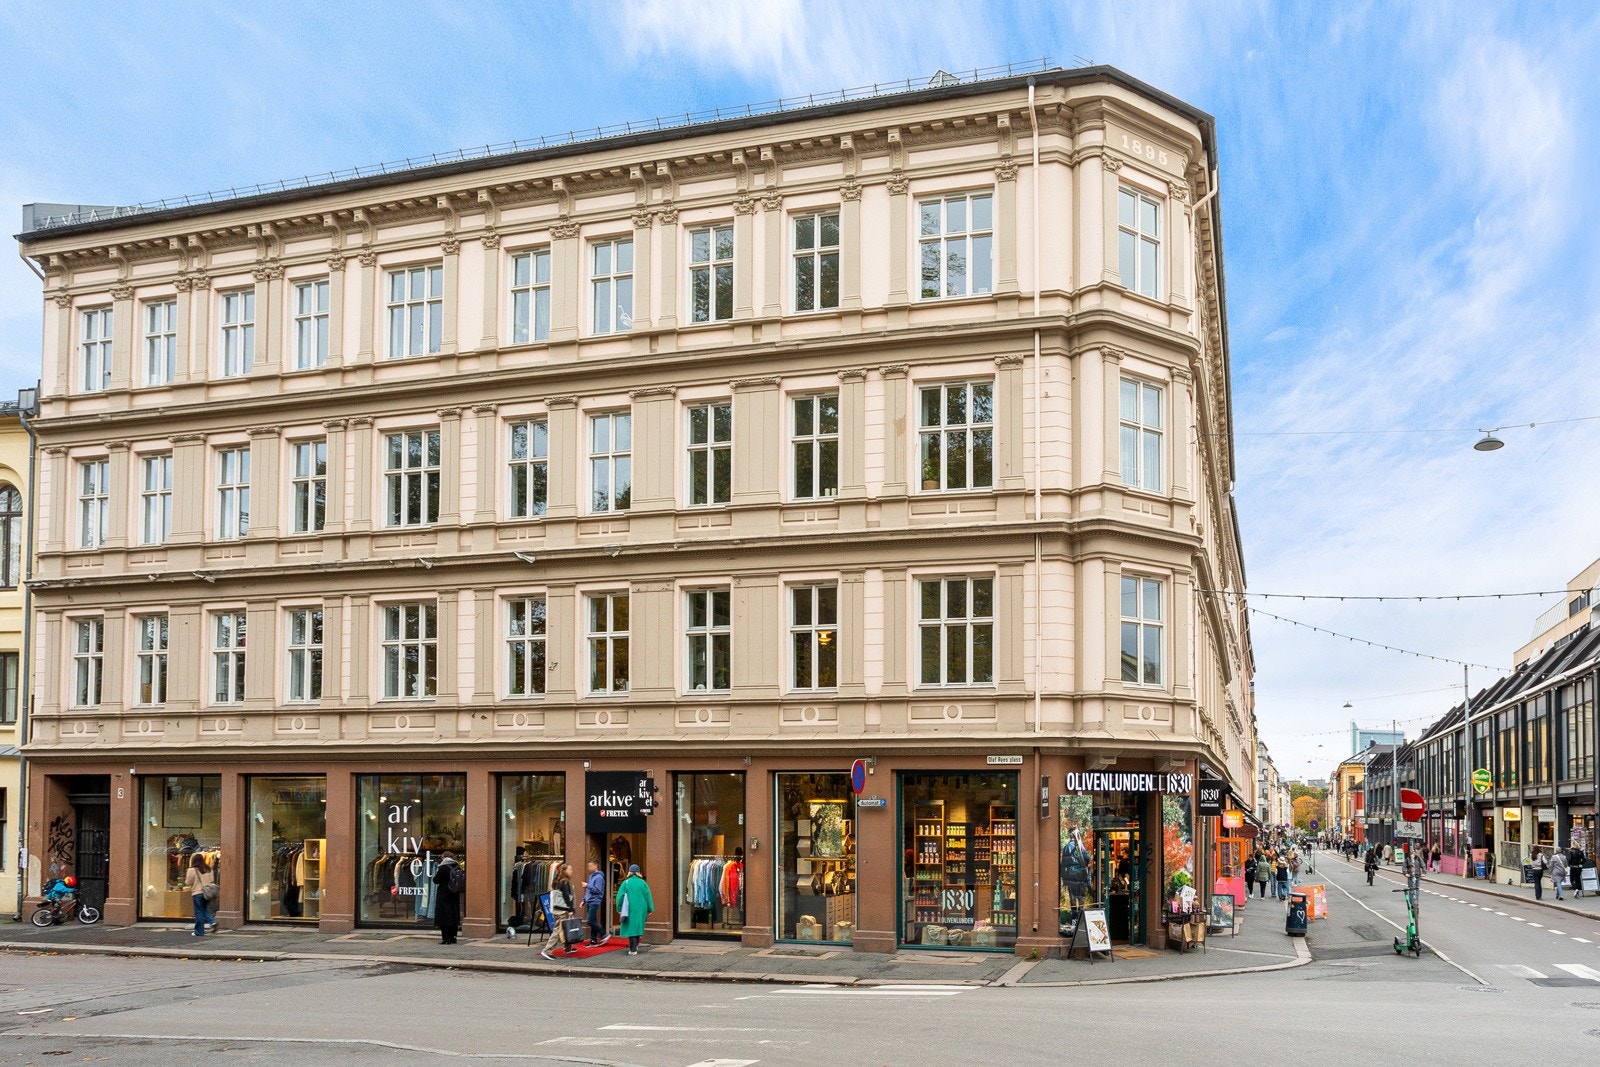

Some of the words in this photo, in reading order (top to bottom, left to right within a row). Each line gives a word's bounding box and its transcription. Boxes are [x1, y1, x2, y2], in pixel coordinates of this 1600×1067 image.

[1122, 135, 1168, 166] 1895
[639, 788, 650, 798] kiv
[1066, 772, 1153, 791] OLIVENLUNDEN
[1166, 773, 1193, 794] 1830
[590, 790, 636, 807] arkive
[1200, 789, 1220, 800] 1830
[388, 804, 412, 824] ar
[387, 827, 424, 855] kiv
[410, 851, 434, 877] et
[399, 887, 428, 896] FRETEX
[941, 890, 976, 911] 1830
